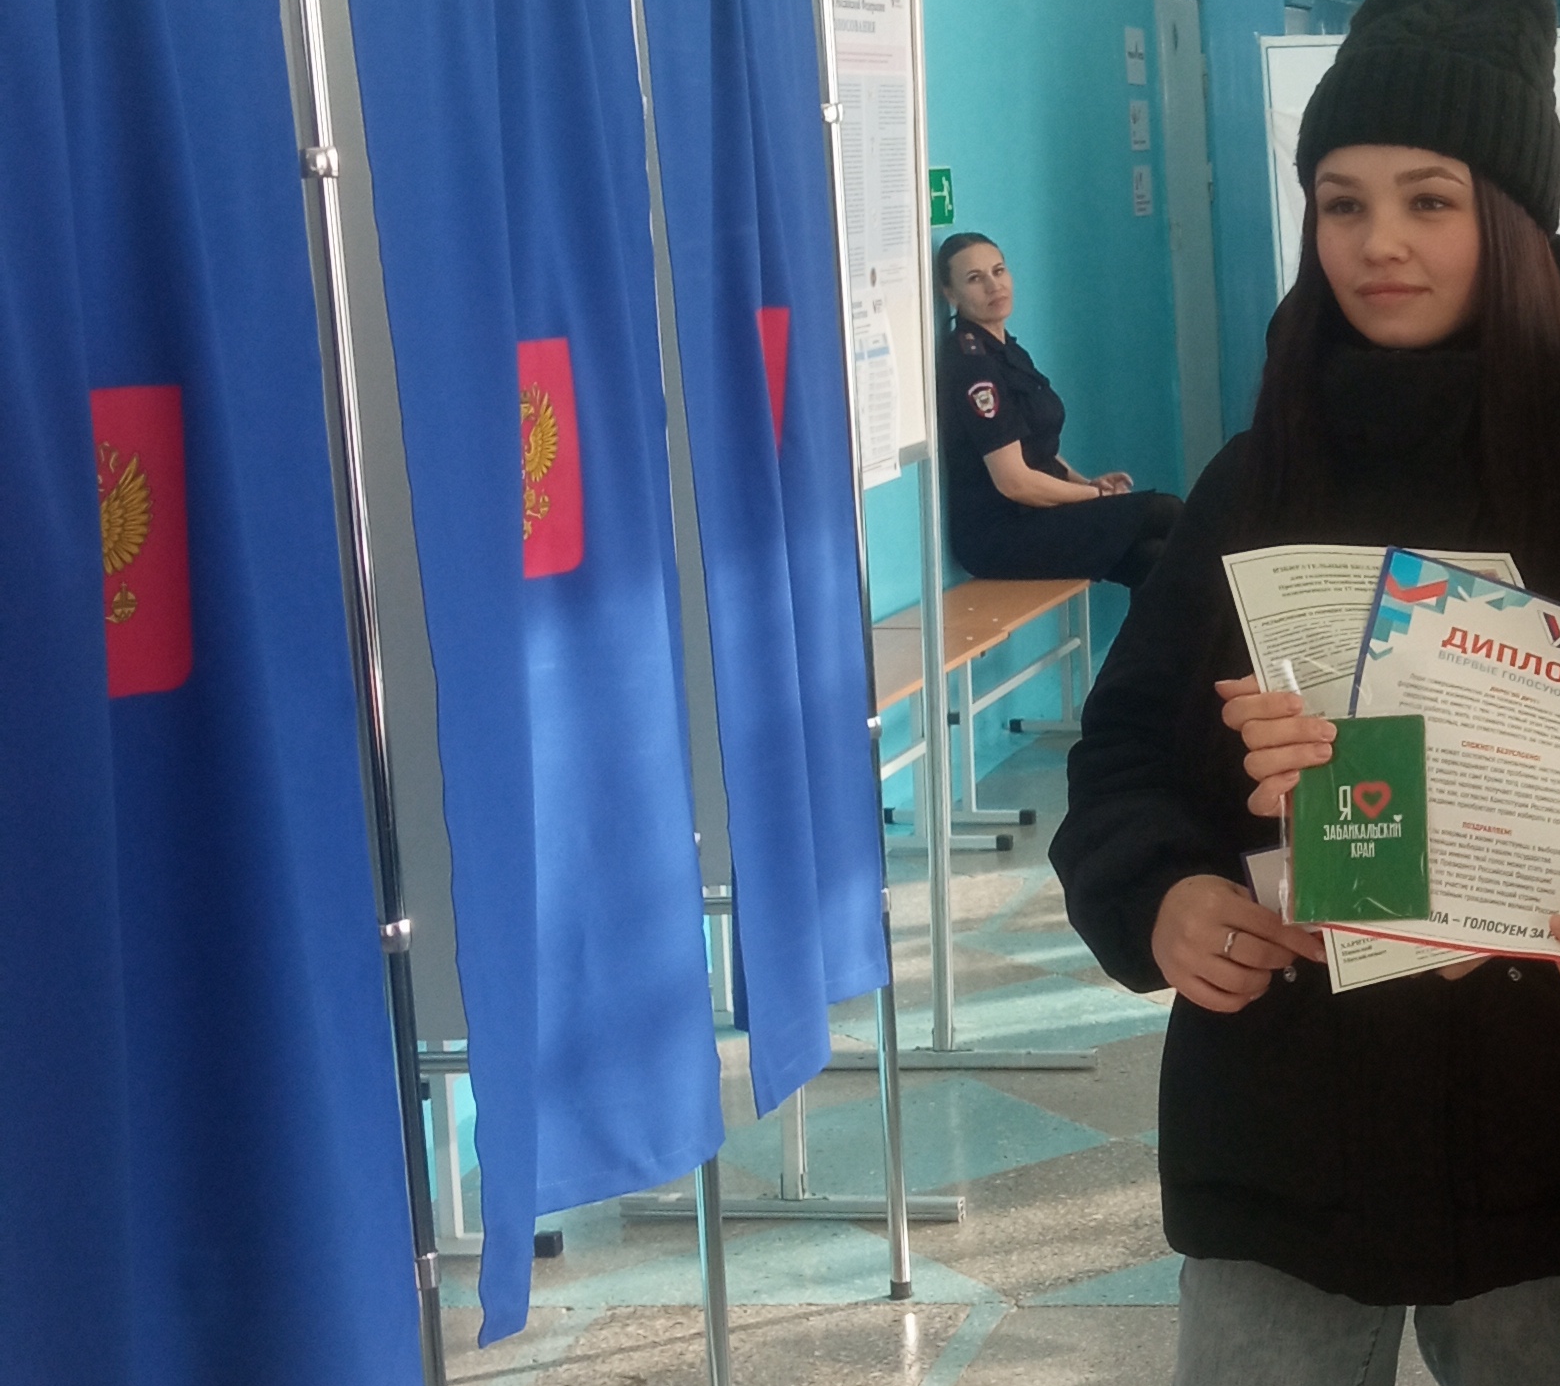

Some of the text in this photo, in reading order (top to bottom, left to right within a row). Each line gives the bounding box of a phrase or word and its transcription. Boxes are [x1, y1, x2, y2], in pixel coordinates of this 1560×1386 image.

[1338, 785, 1352, 821] Я
[1323, 817, 1402, 841] ЗАБАЙКАЛЬСКИЙ
[1350, 839, 1376, 858] КРАЙ
[1462, 915, 1527, 938] ГОЛОСУЕМ
[1529, 927, 1544, 939] ЗА
